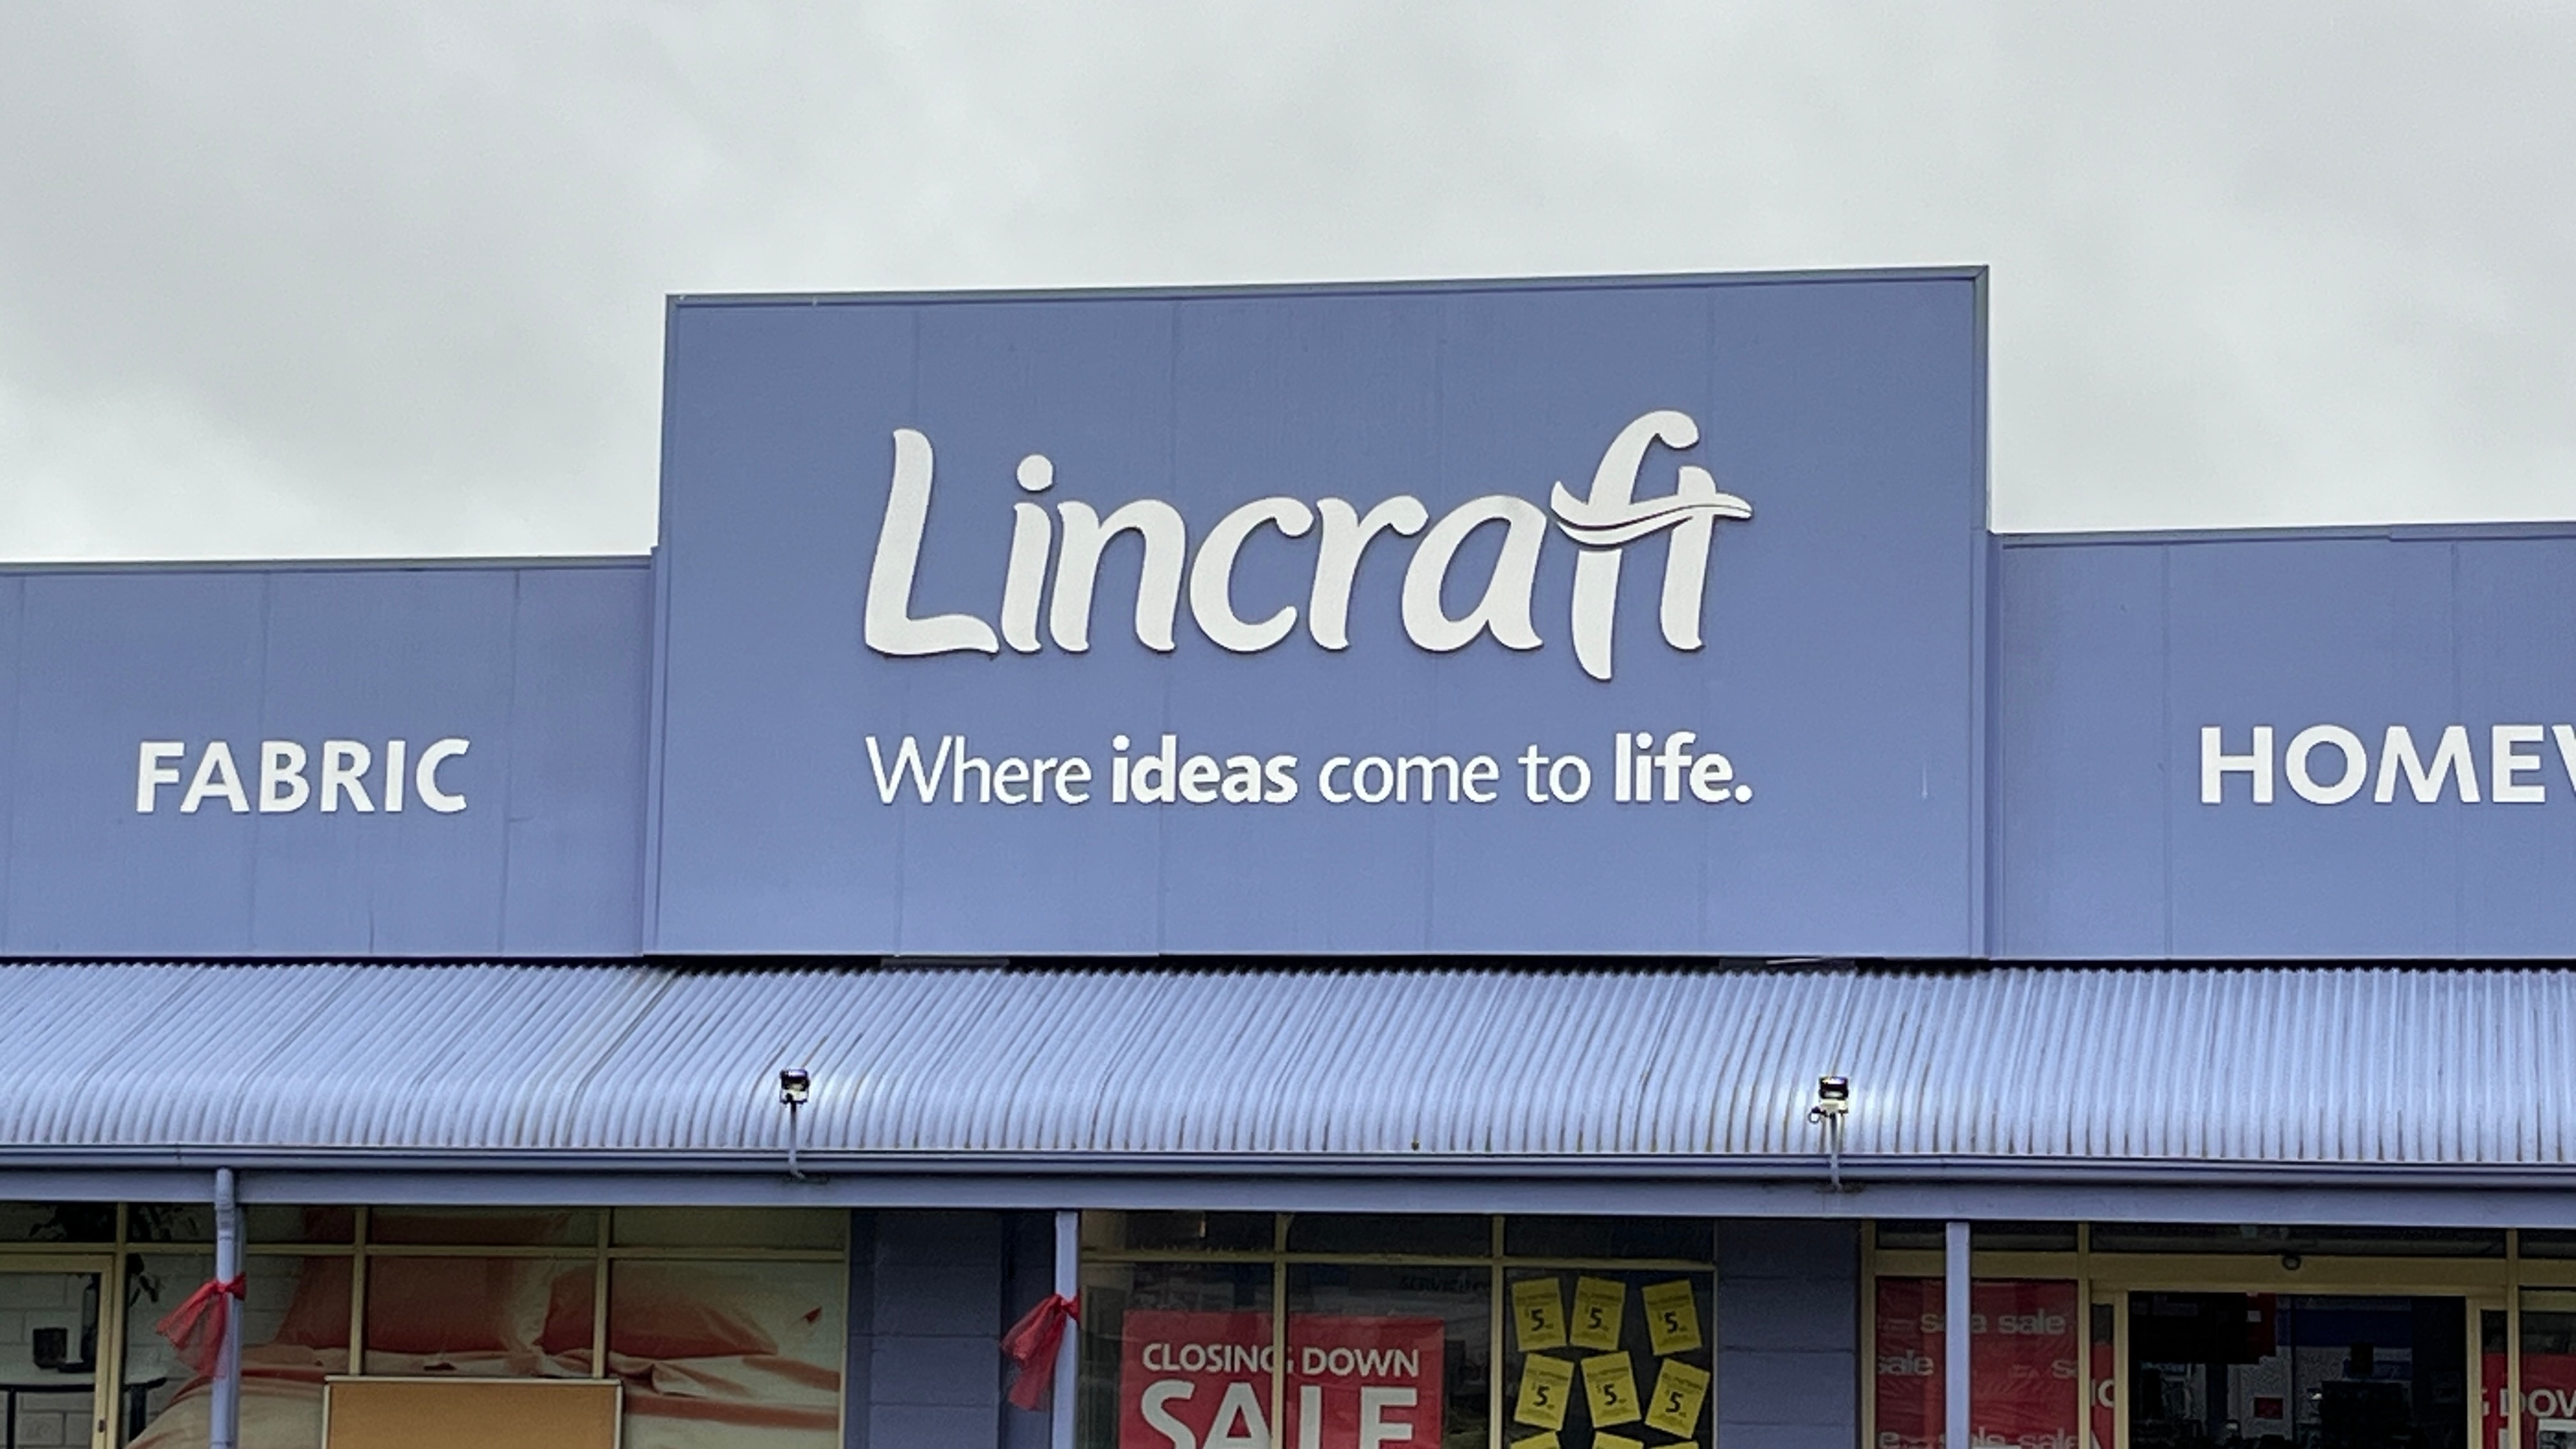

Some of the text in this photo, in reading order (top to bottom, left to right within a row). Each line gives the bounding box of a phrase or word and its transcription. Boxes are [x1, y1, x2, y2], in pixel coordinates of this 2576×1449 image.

[865, 410, 1752, 680] Lincraft
[136, 739, 470, 812] FABRIC
[866, 732, 1753, 804] Where ideas come to life.
[2202, 724, 2576, 805] HOME
[1998, 1308, 2066, 1335] sale
[1303, 1347, 1419, 1377] DOWN
